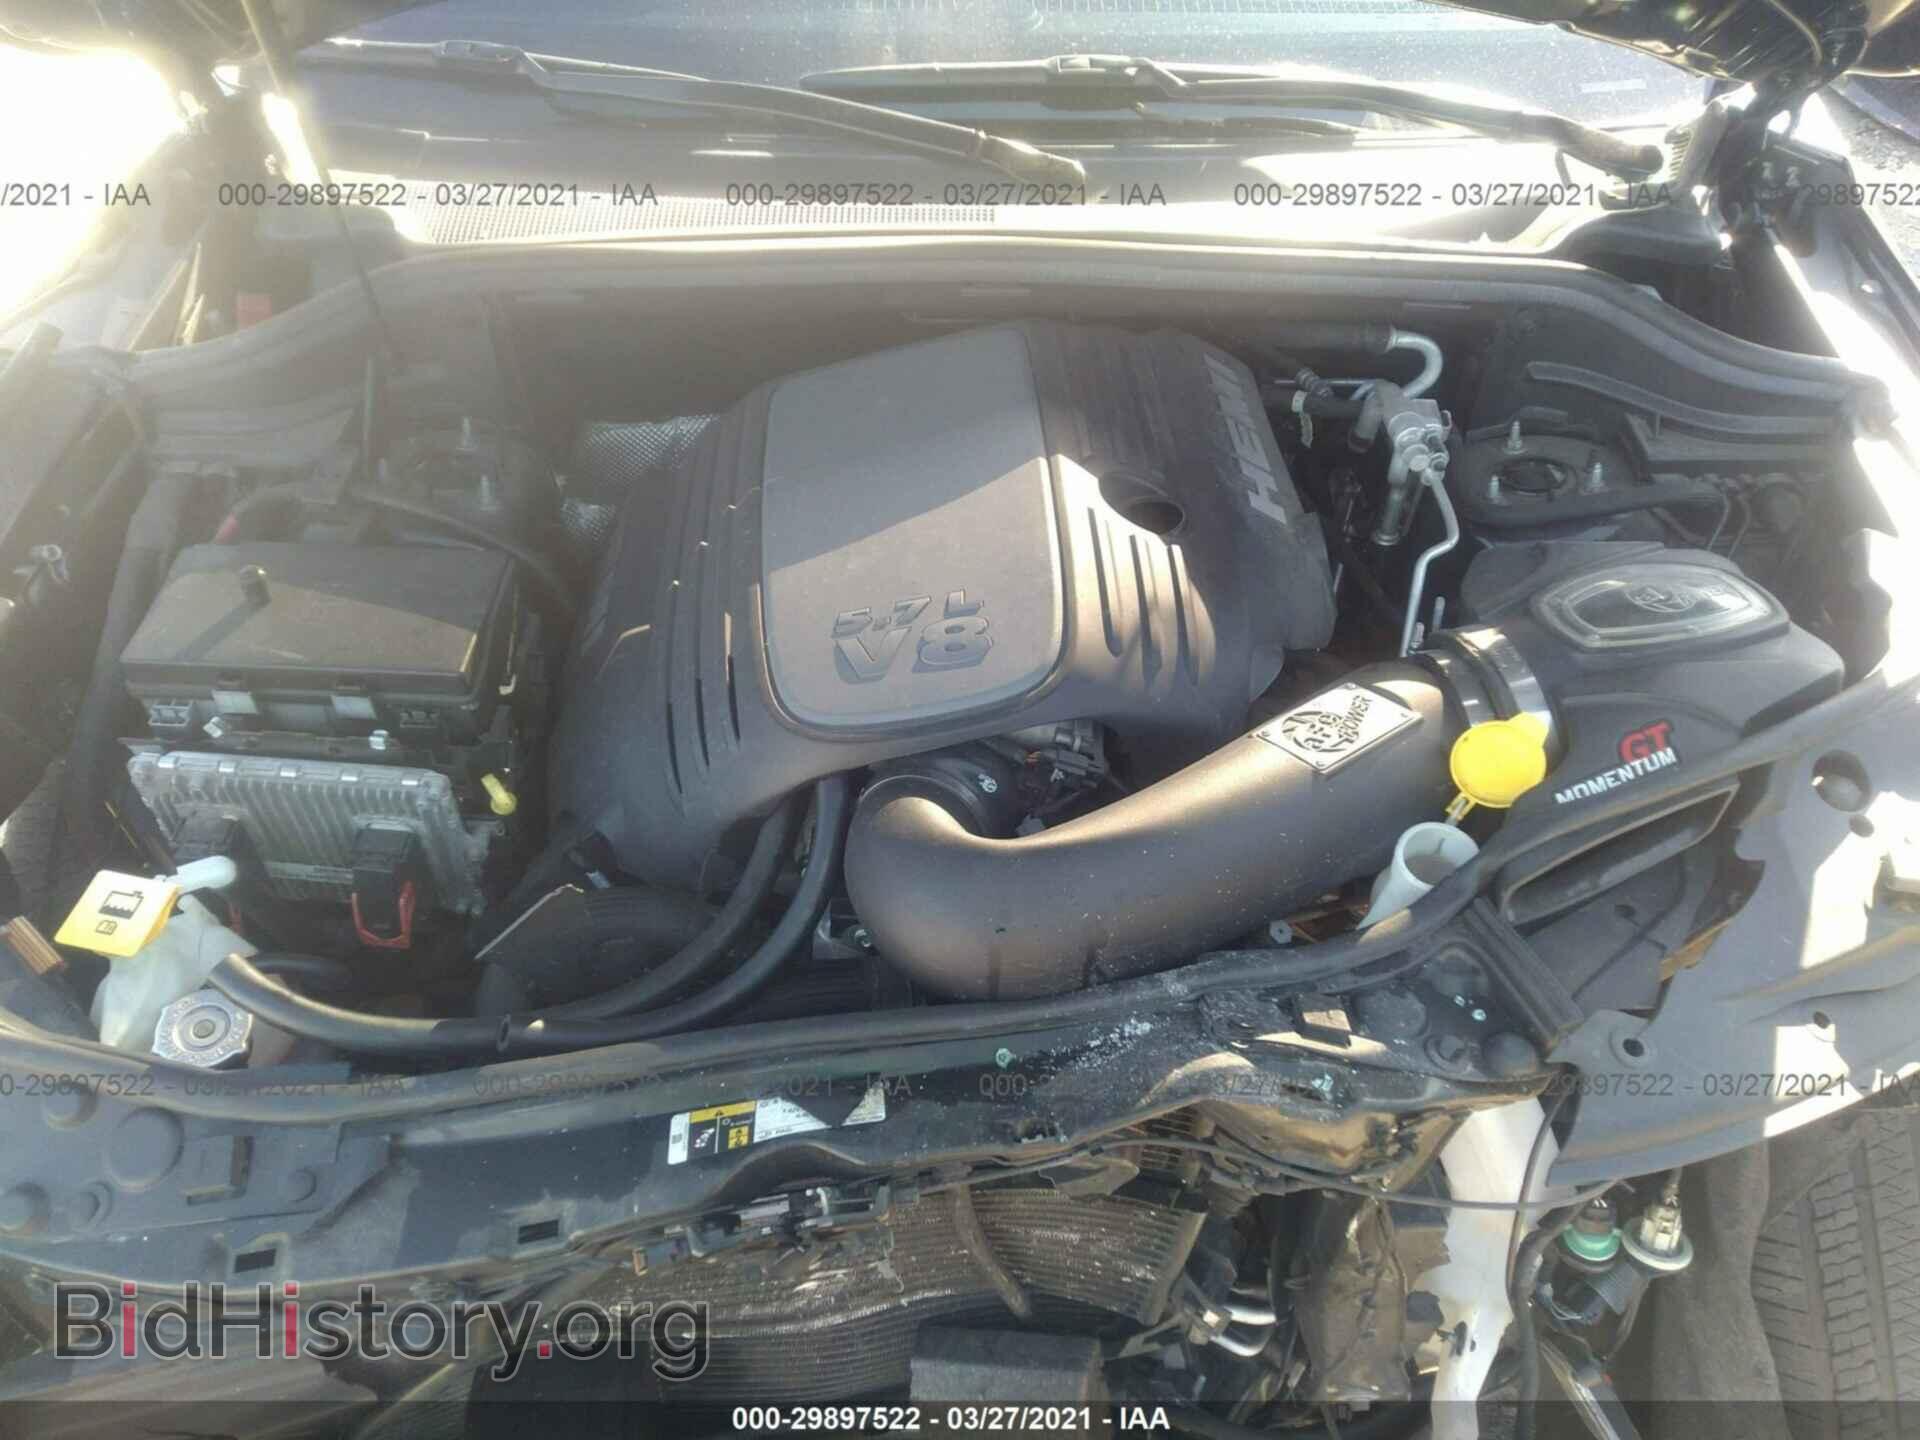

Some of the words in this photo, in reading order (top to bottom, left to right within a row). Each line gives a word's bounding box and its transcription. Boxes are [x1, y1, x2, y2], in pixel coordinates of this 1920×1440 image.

[835, 616, 993, 684] V8
[1618, 720, 1673, 767] GT
[1555, 747, 1677, 803] MOMENTUM
